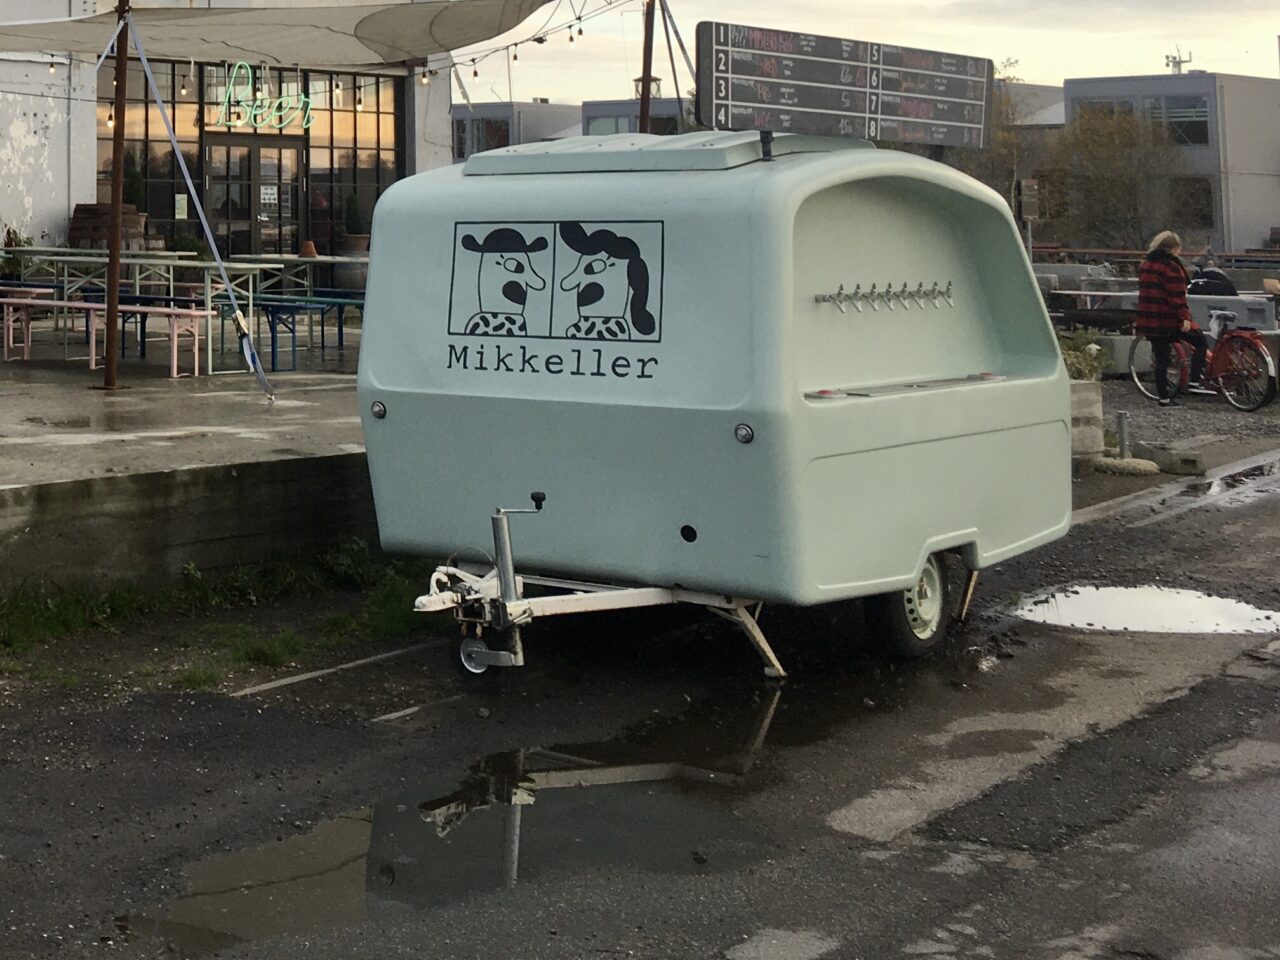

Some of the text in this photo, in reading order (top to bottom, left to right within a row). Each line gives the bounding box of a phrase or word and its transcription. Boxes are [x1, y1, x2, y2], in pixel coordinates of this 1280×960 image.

[720, 25, 725, 43] 1
[718, 52, 726, 71] 2
[871, 45, 879, 61] 5
[871, 70, 878, 87] 6
[216, 61, 316, 129] Beer
[718, 79, 726, 97] 3
[871, 96, 877, 112] 7
[718, 107, 726, 125] 4
[870, 121, 876, 137] 8
[446, 343, 659, 379] Mikkeller
